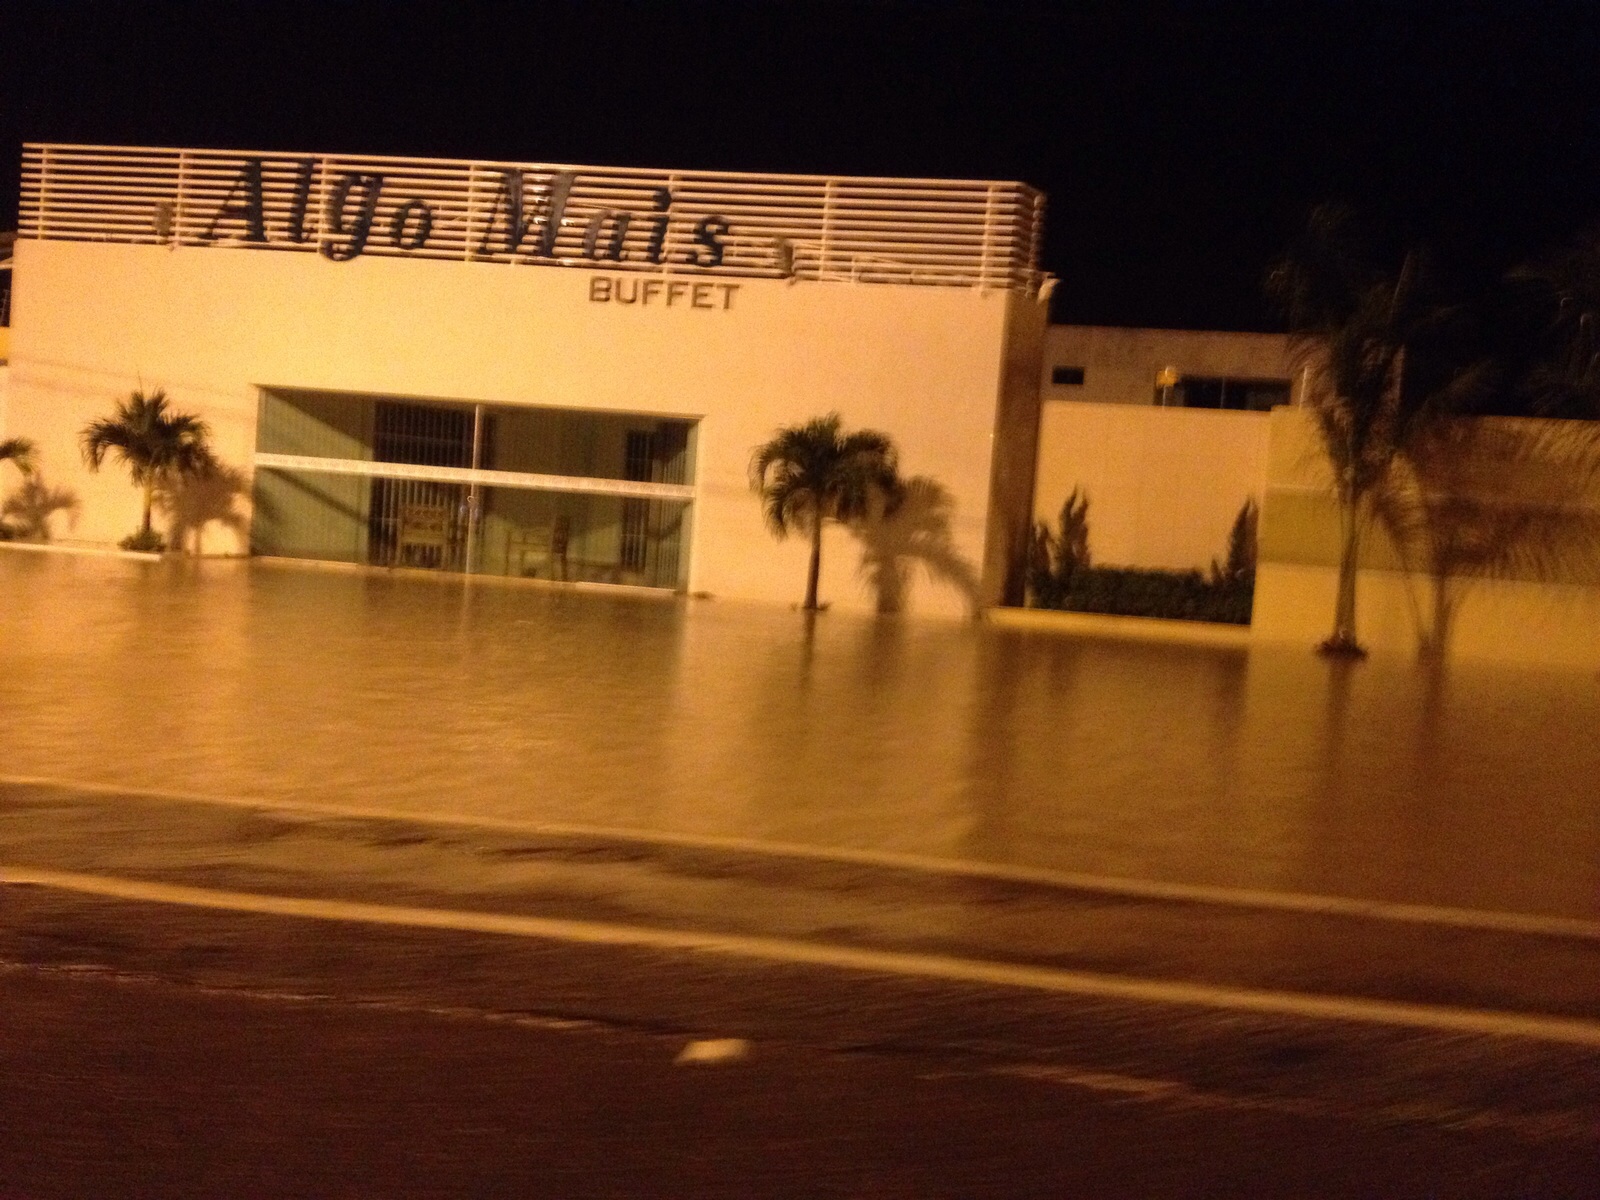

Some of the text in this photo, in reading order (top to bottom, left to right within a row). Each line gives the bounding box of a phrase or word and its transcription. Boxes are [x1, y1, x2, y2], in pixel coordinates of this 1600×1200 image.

[204, 156, 730, 268] Algo Mais
[589, 275, 741, 311] BUFFET
